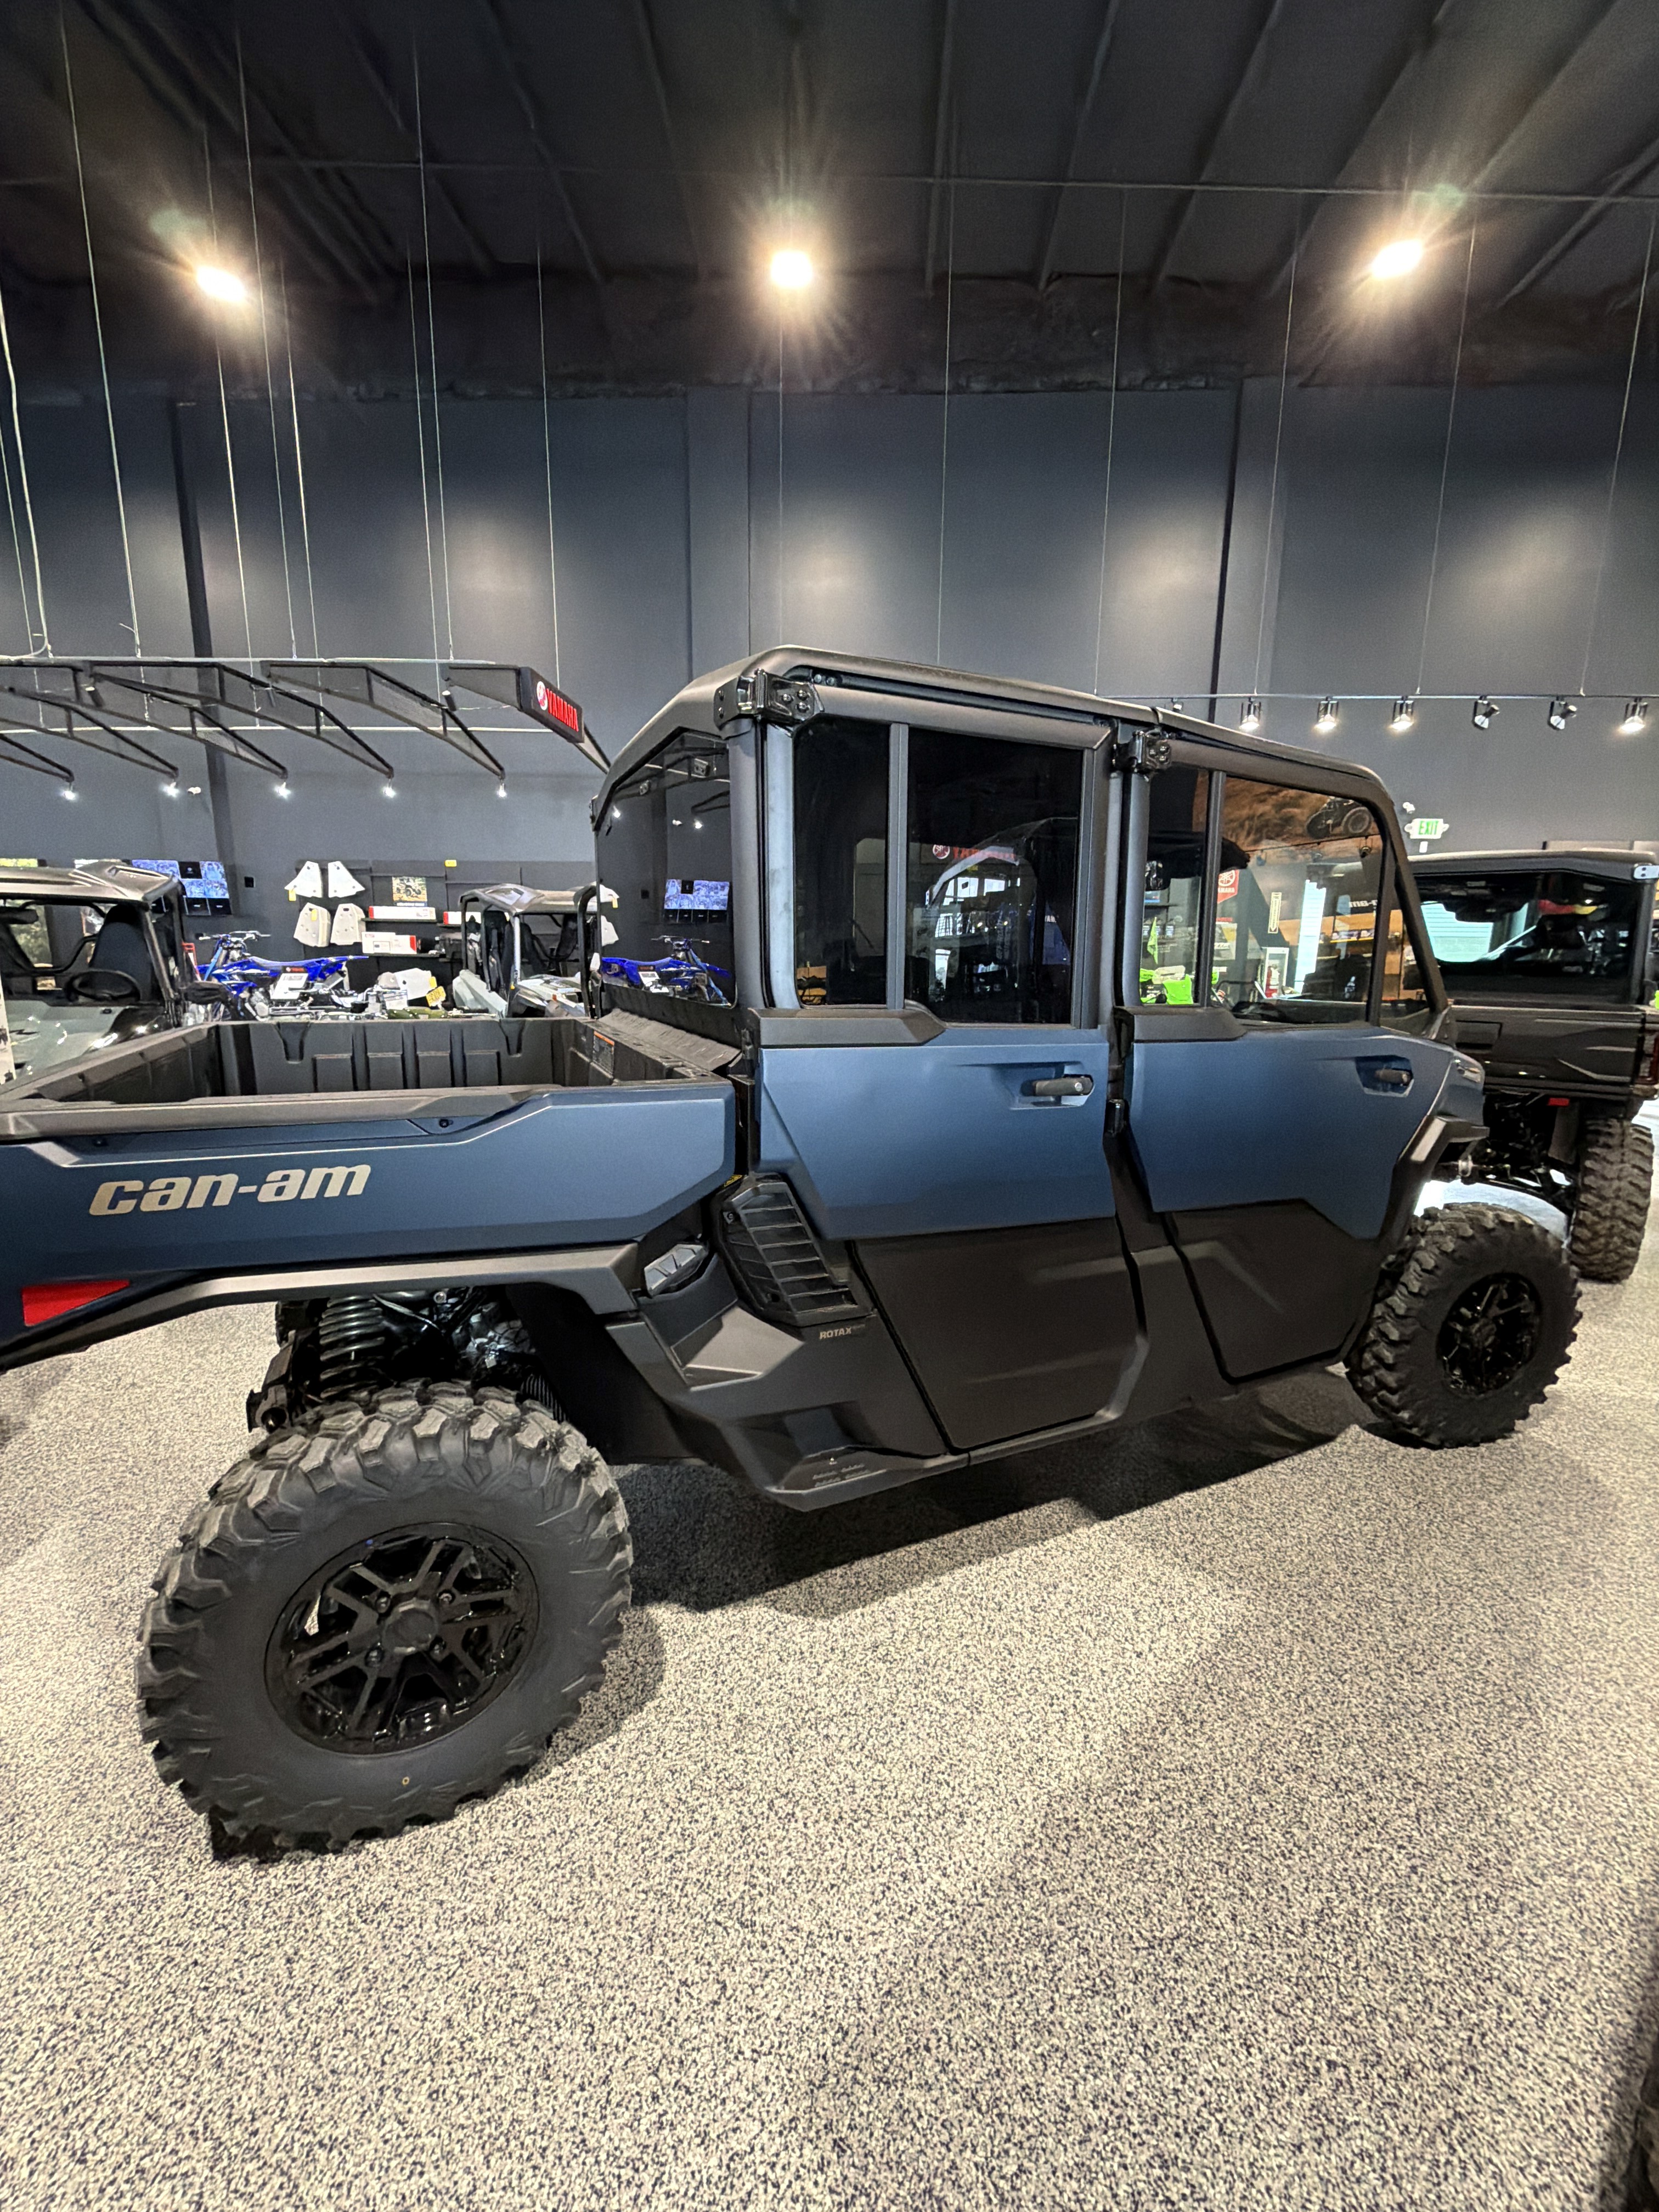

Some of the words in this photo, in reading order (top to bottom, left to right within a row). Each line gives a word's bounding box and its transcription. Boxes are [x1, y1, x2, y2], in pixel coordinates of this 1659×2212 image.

[546, 689, 579, 732] YAMAHA
[1419, 820, 1439, 835] EXIT
[89, 1164, 371, 1216] can-am
[820, 1327, 851, 1340] ROTAX
